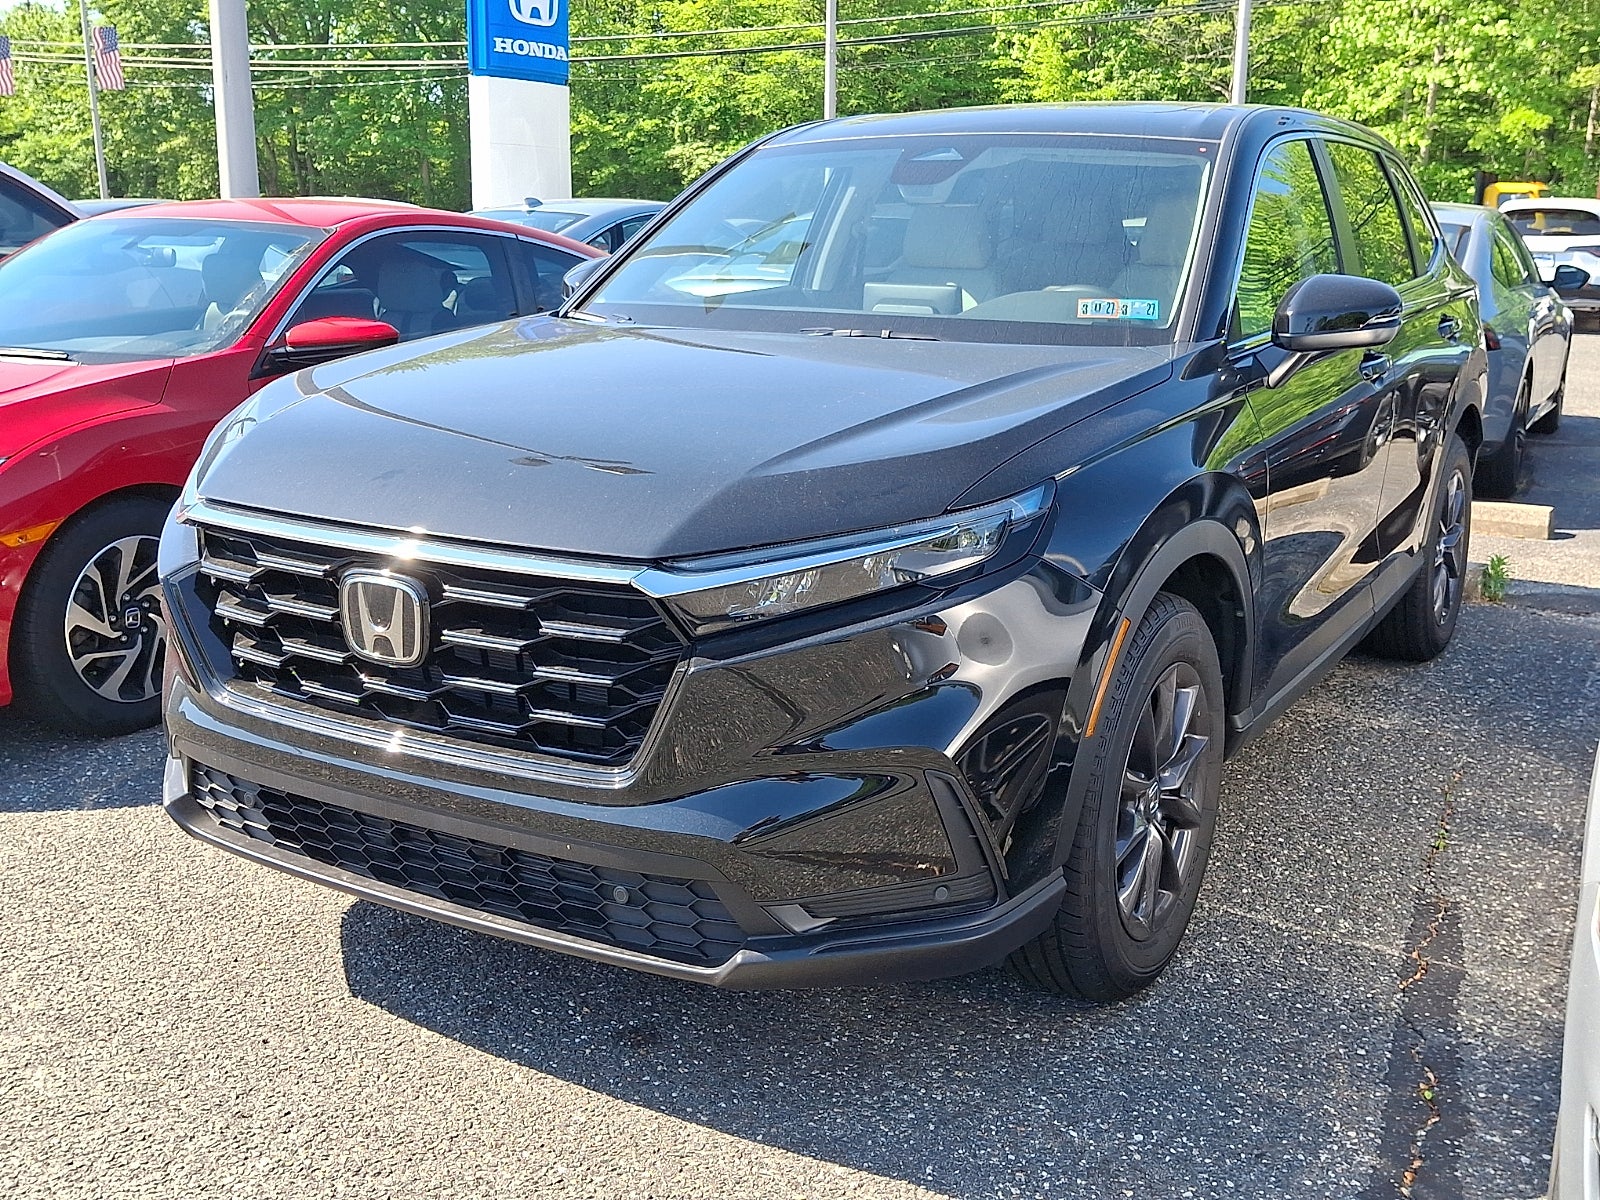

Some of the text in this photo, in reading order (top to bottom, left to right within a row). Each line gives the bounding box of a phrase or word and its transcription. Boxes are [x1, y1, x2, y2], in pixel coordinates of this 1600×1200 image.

[493, 37, 568, 61] HONDA
[1105, 302, 1115, 314] 27
[1146, 303, 1156, 316] 27
